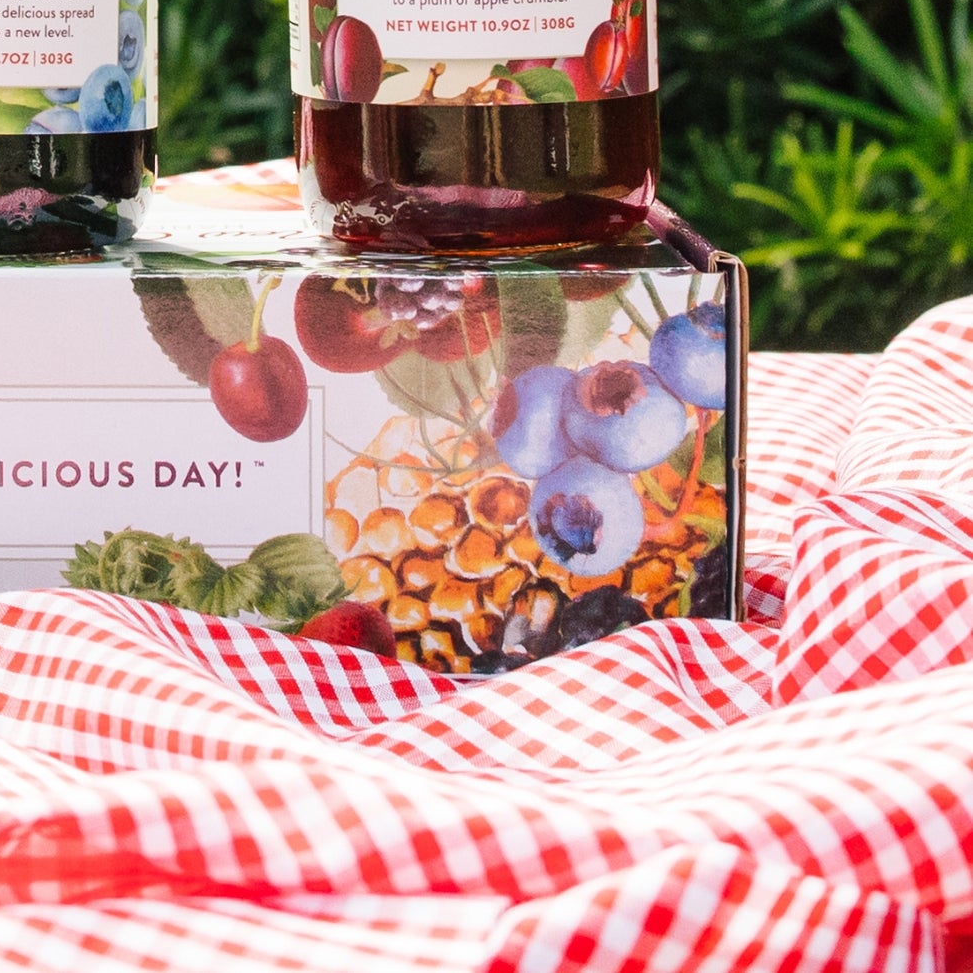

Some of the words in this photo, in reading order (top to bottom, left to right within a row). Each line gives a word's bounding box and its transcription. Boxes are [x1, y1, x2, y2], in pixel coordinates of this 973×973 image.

[1, 4, 57, 19] delicious
[59, 5, 95, 24] spread
[4, 28, 12, 38] a
[15, 28, 41, 38] new
[44, 24, 74, 38] level.
[386, 19, 413, 32] NET
[417, 20, 478, 33] WEIGHT
[481, 18, 530, 32] 10.9OZ
[541, 16, 575, 30] 308G
[40, 52, 73, 65] 303G
[154, 460, 242, 488] DAY!
